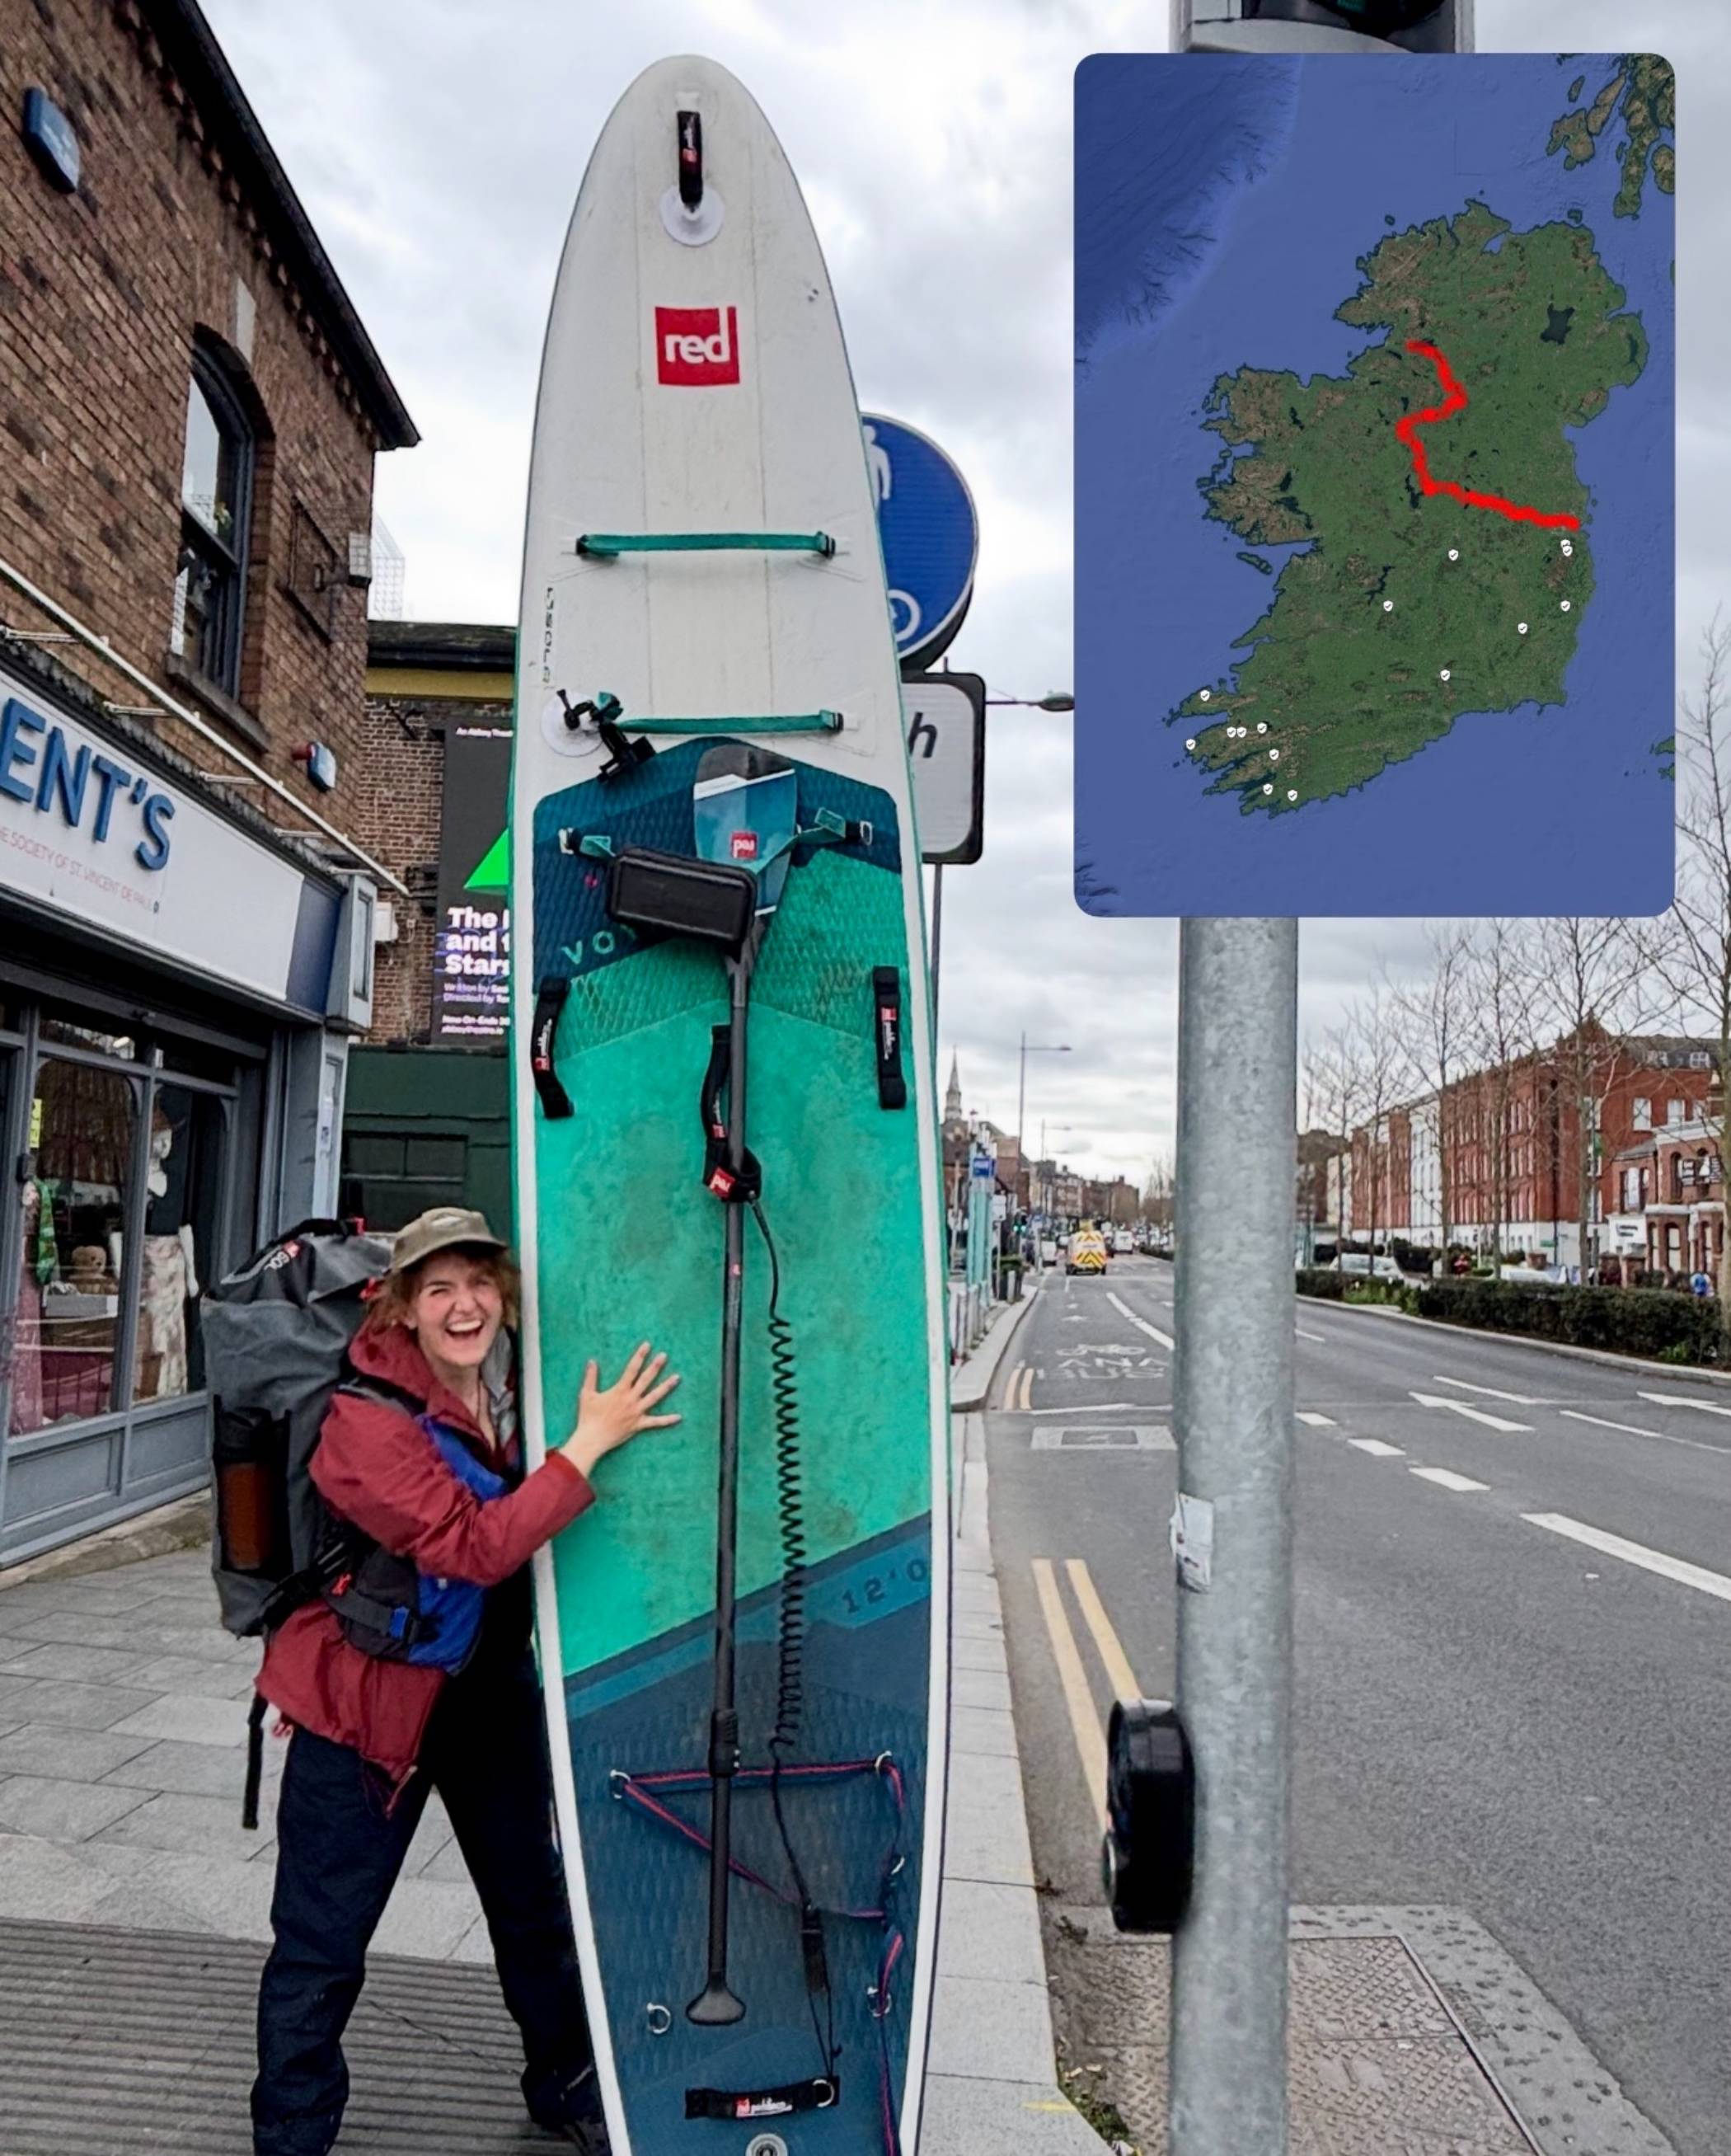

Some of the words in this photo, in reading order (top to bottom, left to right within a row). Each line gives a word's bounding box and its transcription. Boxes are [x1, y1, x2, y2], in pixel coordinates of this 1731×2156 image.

[664, 305, 731, 364] red
[0, 697, 176, 871] ENT'S
[11, 831, 54, 864] SOCIETY
[733, 839, 755, 858] red
[447, 905, 499, 929] The
[446, 929, 497, 952] and
[443, 993, 482, 1003] Directed
